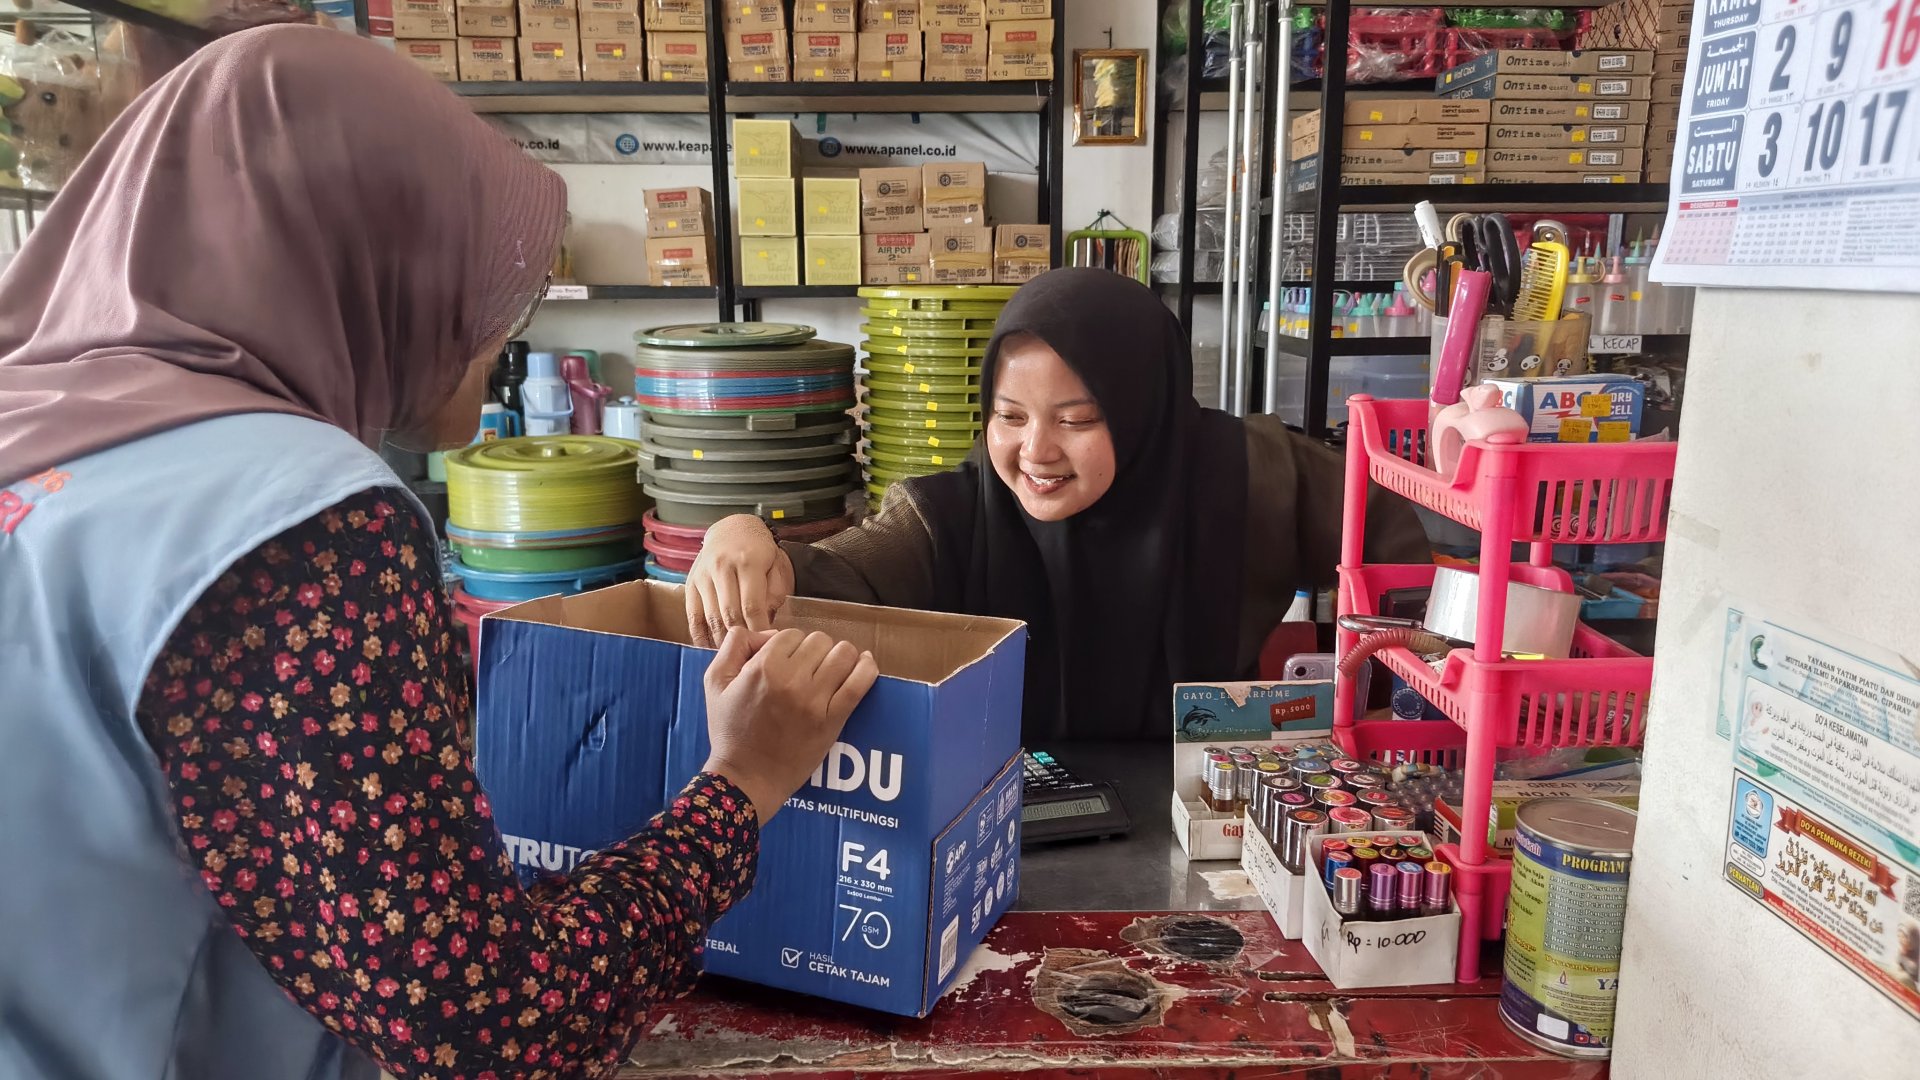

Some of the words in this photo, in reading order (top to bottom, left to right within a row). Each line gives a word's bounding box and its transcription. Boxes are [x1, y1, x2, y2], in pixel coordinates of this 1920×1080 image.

[1713, 13, 1749, 29] THURSDAY
[1877, 0, 1920, 70] 16
[1825, 10, 1853, 82] 9
[473, 52, 504, 60] THERMO
[1506, 55, 1551, 66] OnTime
[1768, 24, 1796, 92] 2
[1503, 80, 1548, 91] OnTime
[1697, 58, 1749, 96] JUM'AT
[1500, 104, 1544, 115] OnTime
[1706, 97, 1731, 109] FRIDAY
[1496, 128, 1541, 138] OnTime
[1803, 99, 1846, 172] 10
[1858, 89, 1911, 167] 17
[845, 143, 956, 158] www.apanel.co.id
[1757, 111, 1783, 178] 3
[1493, 152, 1538, 161] OnTime
[1686, 141, 1736, 175] SABTU
[1691, 177, 1725, 188] SATURDAY
[1602, 338, 1640, 350] KECAP
[1611, 391, 1633, 403] DRY
[1807, 655, 1835, 673] YAYASAN
[1836, 667, 1858, 682] YATIM
[1859, 677, 1879, 691] PIATU
[1880, 685, 1895, 698] DAN
[1813, 668, 1829, 680] ILMU
[1881, 697, 1912, 717] CIPARAY
[1828, 717, 1869, 748] KESELAMATAN
[817, 802, 899, 829] MULTIFUNGSI
[1222, 823, 1244, 838] Gay
[1800, 819, 1816, 835] DO'A
[1816, 830, 1848, 855] PEMBUKA
[1848, 848, 1872, 868] REZEKI
[841, 841, 891, 880] F4
[1562, 853, 1625, 874] PROGRAM
[839, 874, 852, 884] 216
[860, 880, 876, 889] 330
[877, 883, 893, 893] mm
[839, 903, 892, 949] 70
[861, 925, 880, 935] GSM
[705, 938, 740, 955] TEBAL
[809, 951, 835, 964] HASIL
[808, 961, 848, 978] CETAK
[850, 970, 891, 988] TAJAM
[1598, 978, 1619, 991] YA
